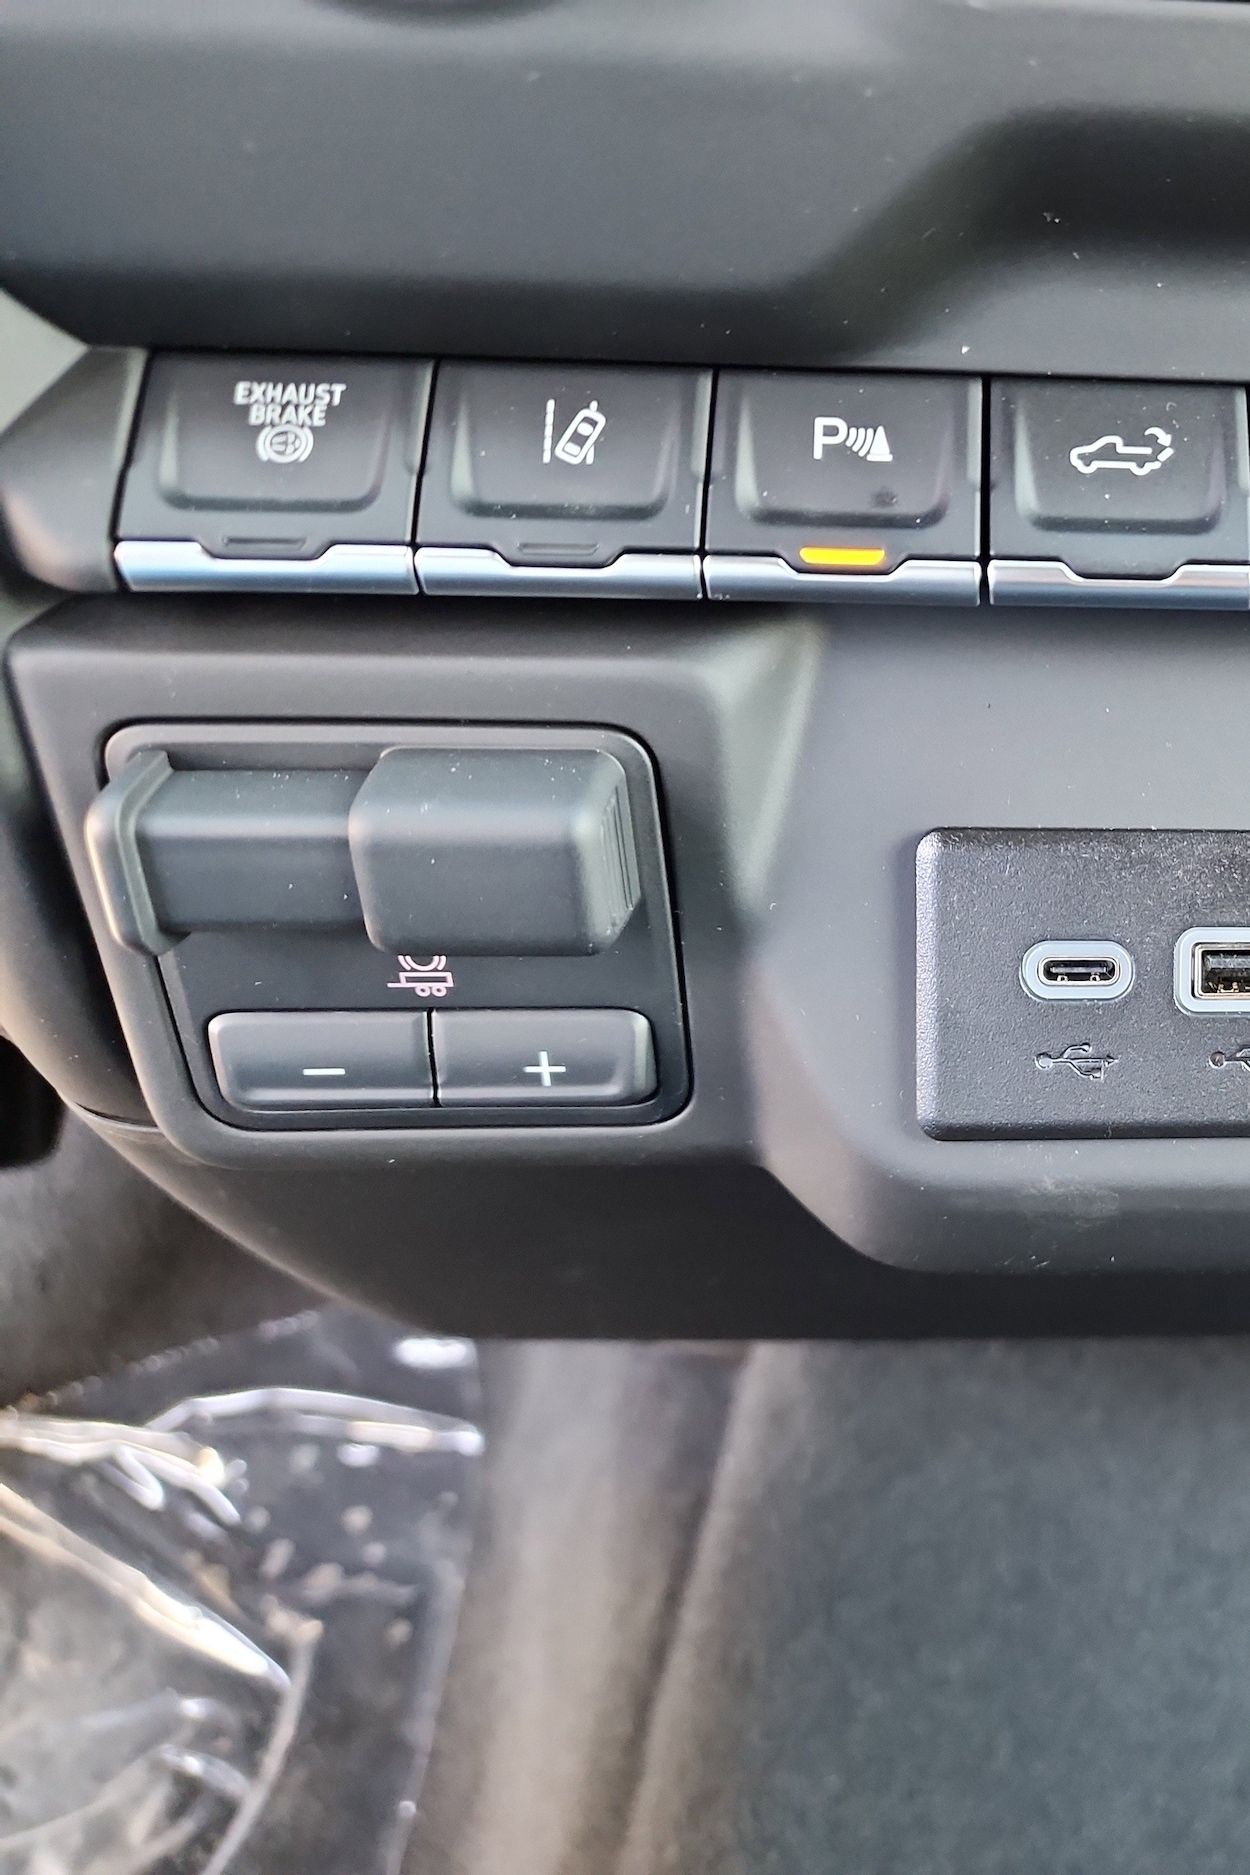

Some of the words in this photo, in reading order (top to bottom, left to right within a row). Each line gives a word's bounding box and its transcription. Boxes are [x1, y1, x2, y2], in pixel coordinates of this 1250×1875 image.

[234, 381, 347, 406] EXHAUST
[248, 403, 327, 427] BRAKE
[813, 416, 848, 460] P
